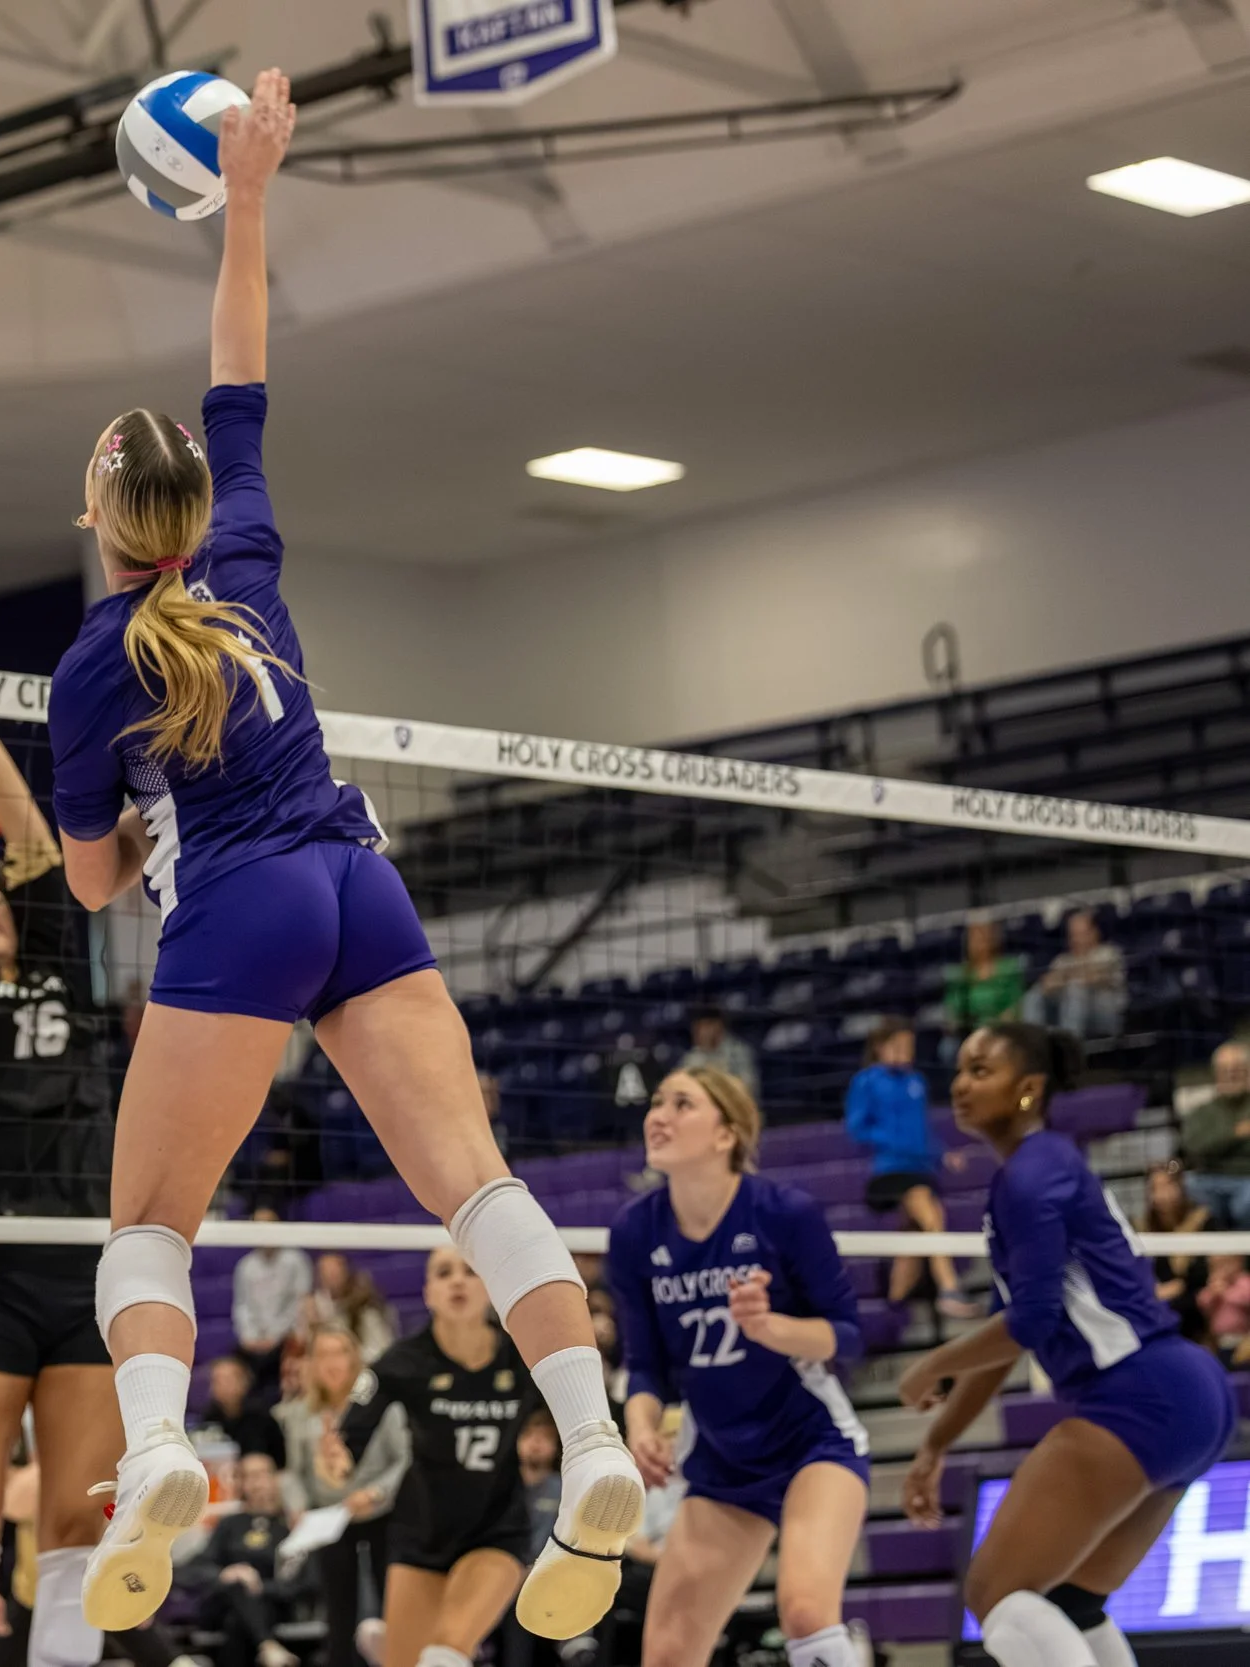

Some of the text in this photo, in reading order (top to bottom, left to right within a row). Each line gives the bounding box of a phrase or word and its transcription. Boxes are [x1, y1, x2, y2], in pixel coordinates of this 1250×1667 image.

[496, 735, 801, 797] HOLY CROSS CRUSADERS
[952, 787, 1198, 842] HOLY CROSS CRUSADERS
[677, 1306, 747, 1368] 22
[454, 1425, 501, 1472] 12
